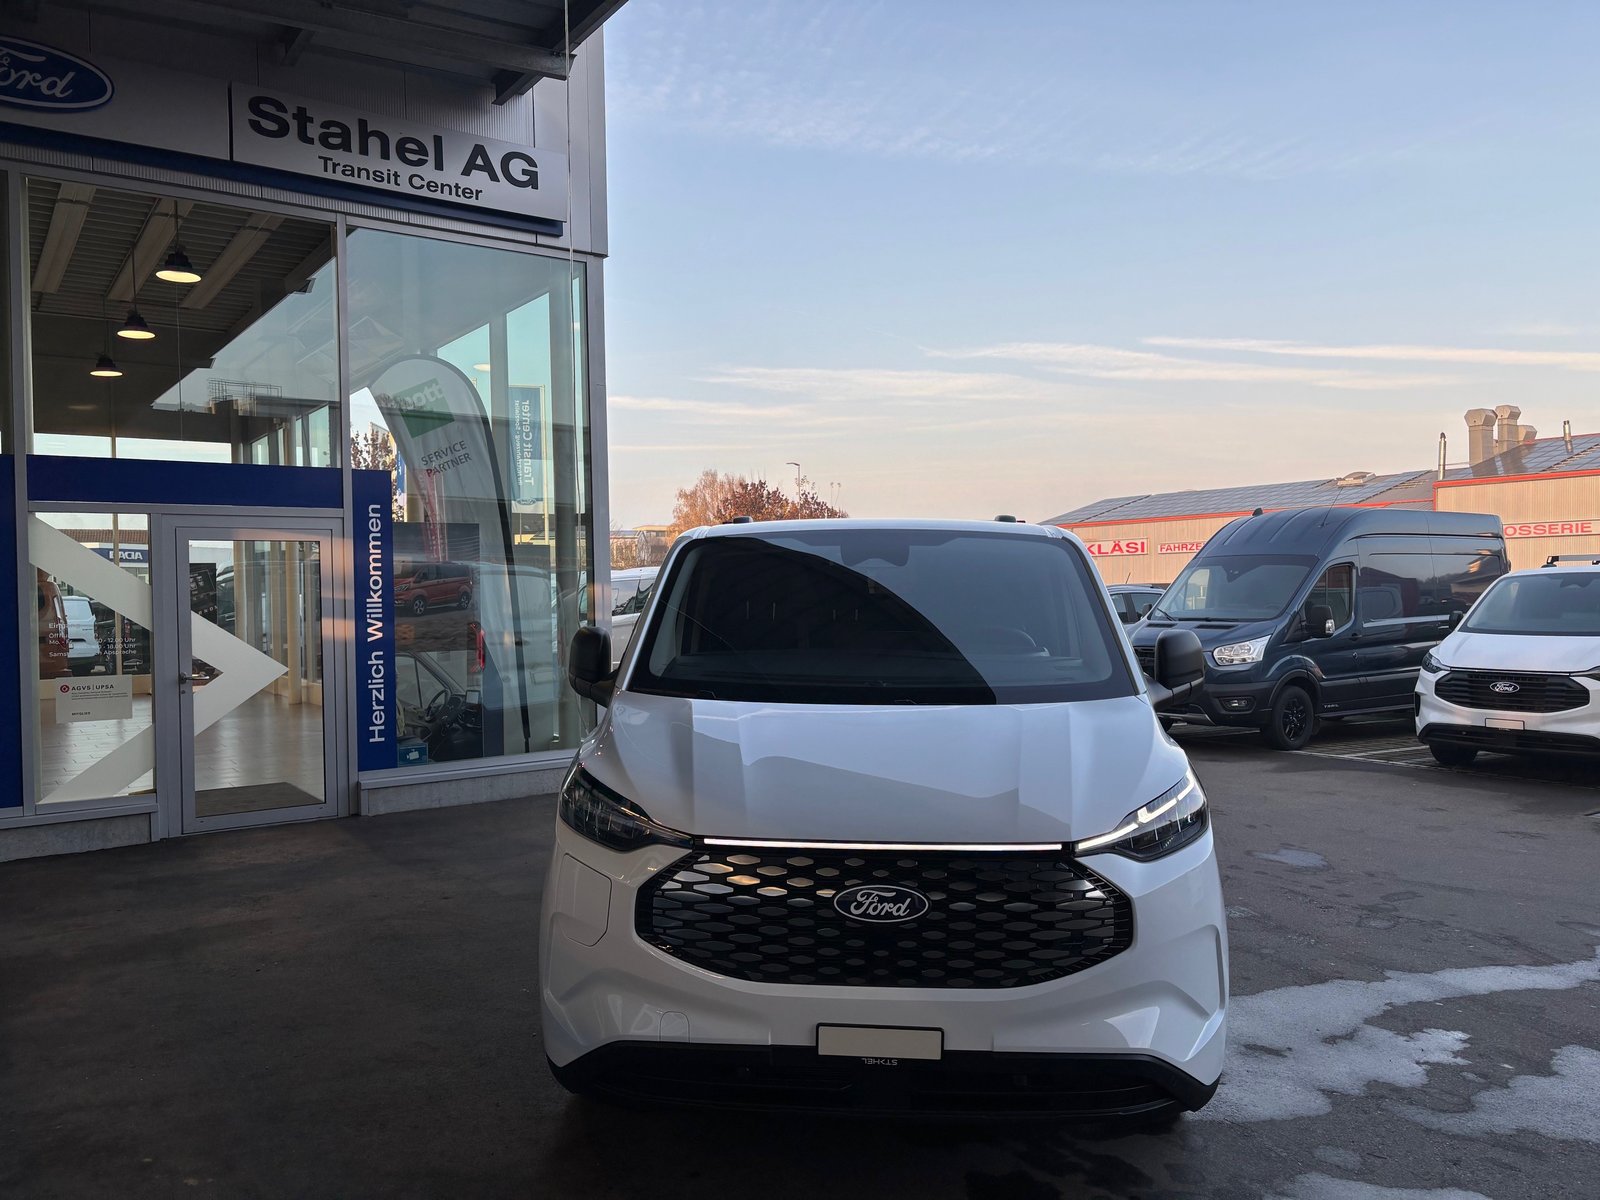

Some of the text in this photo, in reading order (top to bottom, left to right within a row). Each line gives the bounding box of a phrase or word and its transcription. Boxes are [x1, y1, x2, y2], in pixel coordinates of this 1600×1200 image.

[248, 95, 539, 190] Stahel AG
[318, 154, 483, 200] Transit Center
[420, 440, 468, 466] SERVICE
[426, 452, 472, 478] PARTNER
[1504, 522, 1593, 537] OSSERIE
[1160, 543, 1203, 552] FAHRZE
[366, 504, 385, 743] Herzlich Willkommen
[850, 889, 912, 917] Ford
